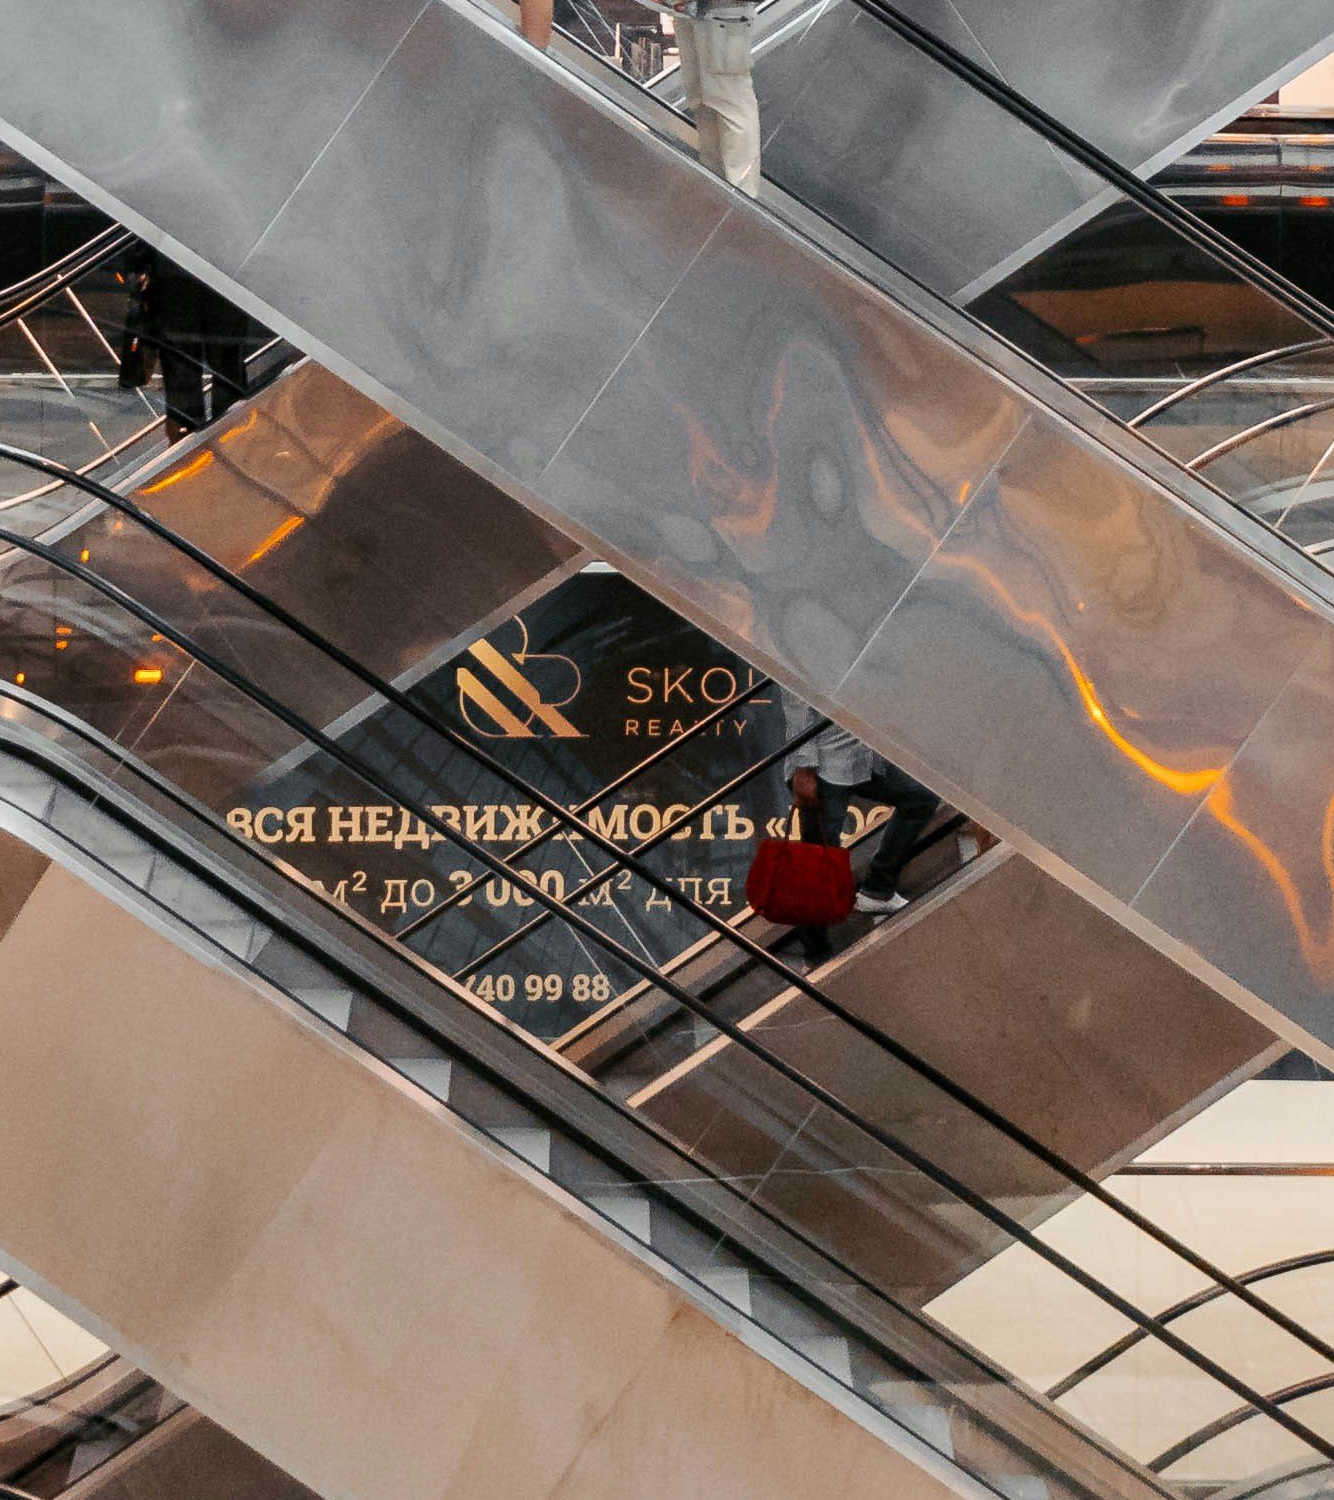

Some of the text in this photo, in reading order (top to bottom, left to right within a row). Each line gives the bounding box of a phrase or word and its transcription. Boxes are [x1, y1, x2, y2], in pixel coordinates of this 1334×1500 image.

[625, 719, 748, 737] REATY
[380, 878, 435, 914] до
[524, 973, 564, 1002] 99
[572, 973, 611, 1002] 88
